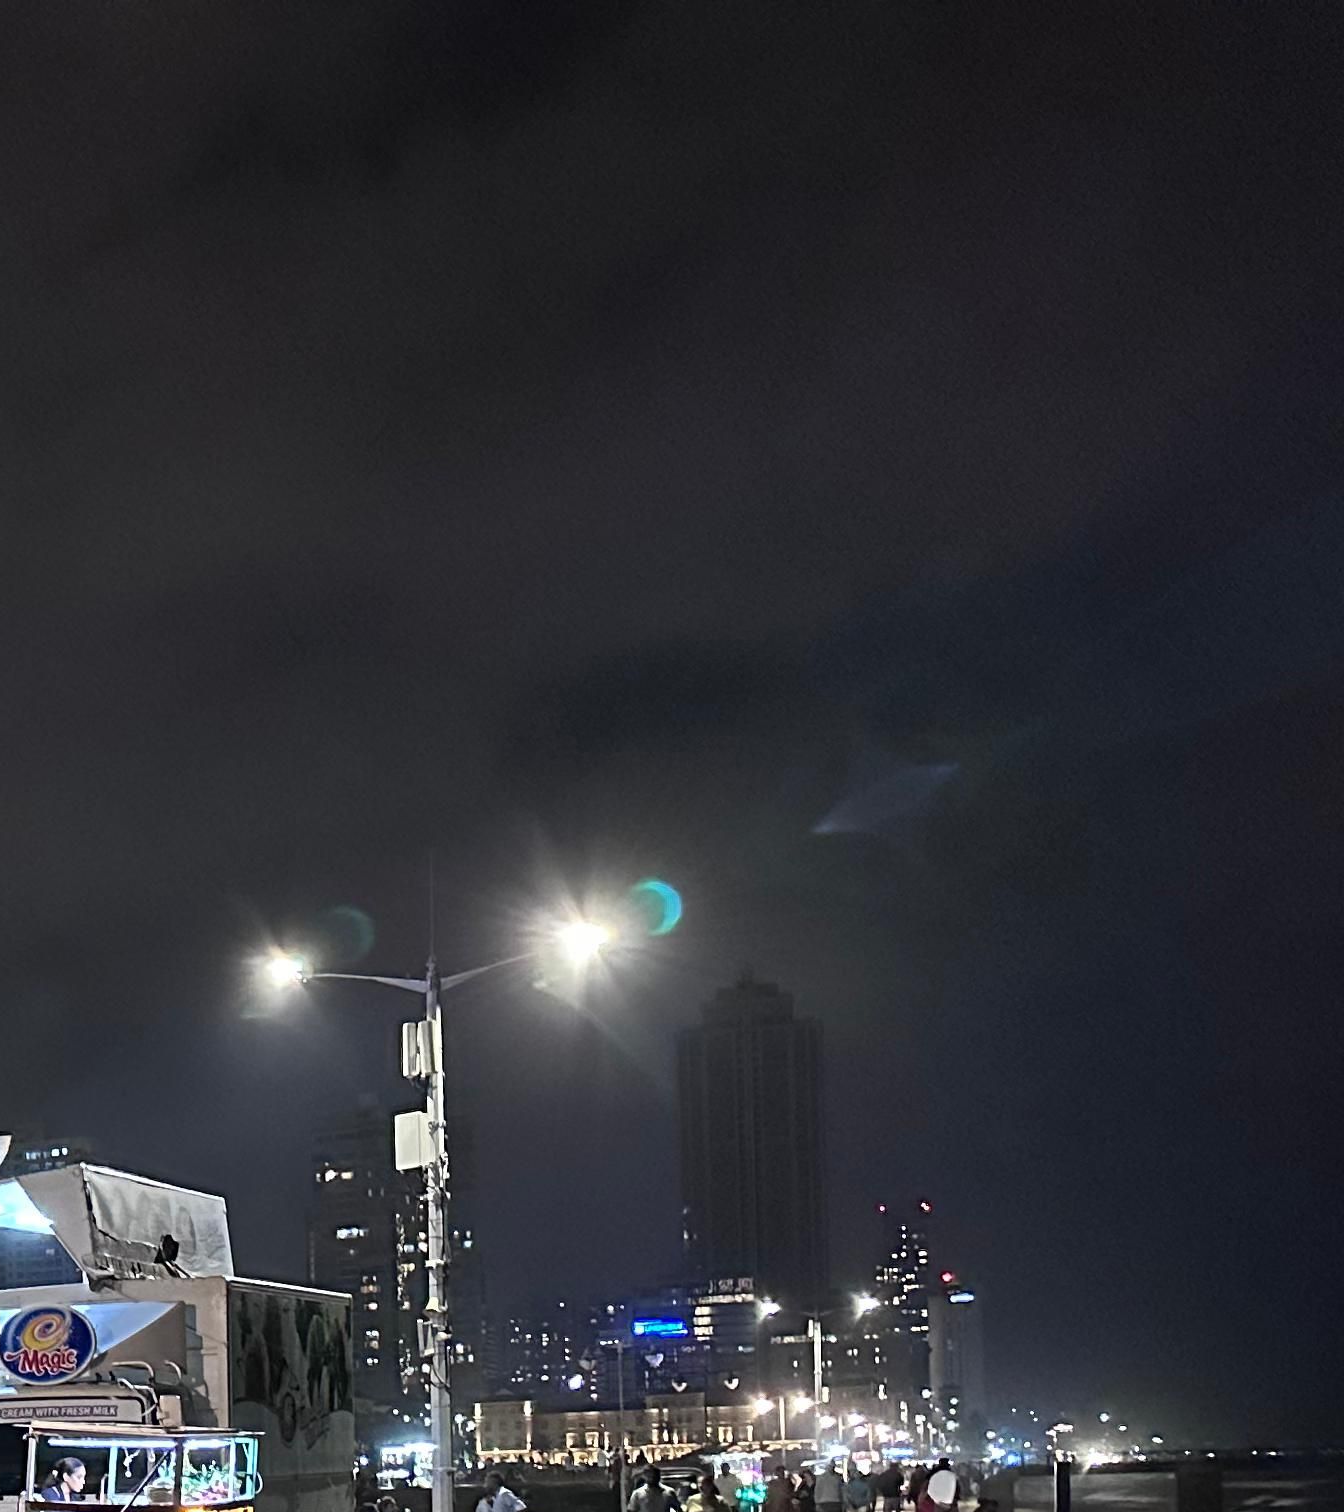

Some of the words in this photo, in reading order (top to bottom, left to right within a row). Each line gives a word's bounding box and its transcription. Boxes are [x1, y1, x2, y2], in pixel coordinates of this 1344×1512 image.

[4, 1345, 78, 1377] Magic
[1, 1408, 33, 1419] CREAM
[35, 1407, 60, 1417] WITH
[60, 1406, 92, 1416] FRESH
[92, 1405, 117, 1416] MILK
